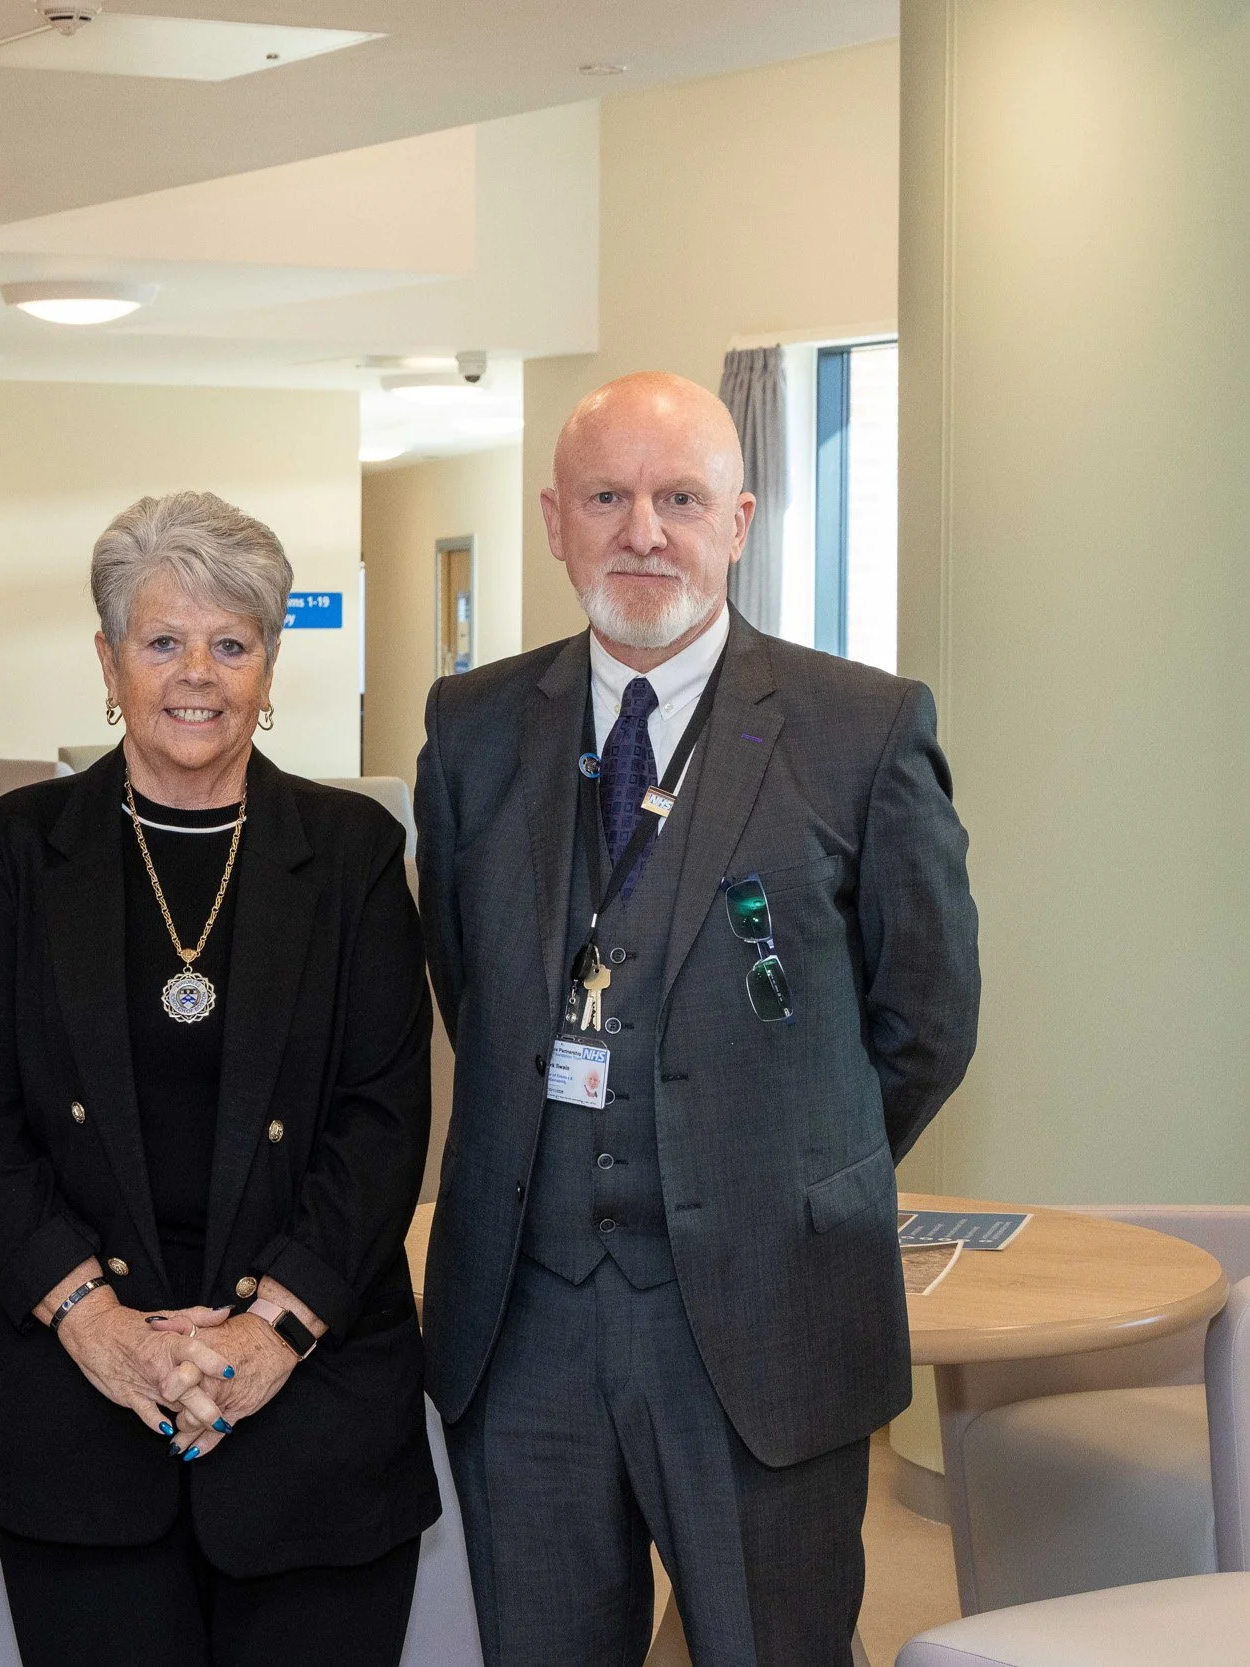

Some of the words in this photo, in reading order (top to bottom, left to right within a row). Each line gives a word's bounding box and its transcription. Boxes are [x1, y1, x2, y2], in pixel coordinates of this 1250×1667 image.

[287, 598, 305, 608] ms
[307, 596, 330, 608] 1-19
[582, 1048, 606, 1062] NHS
